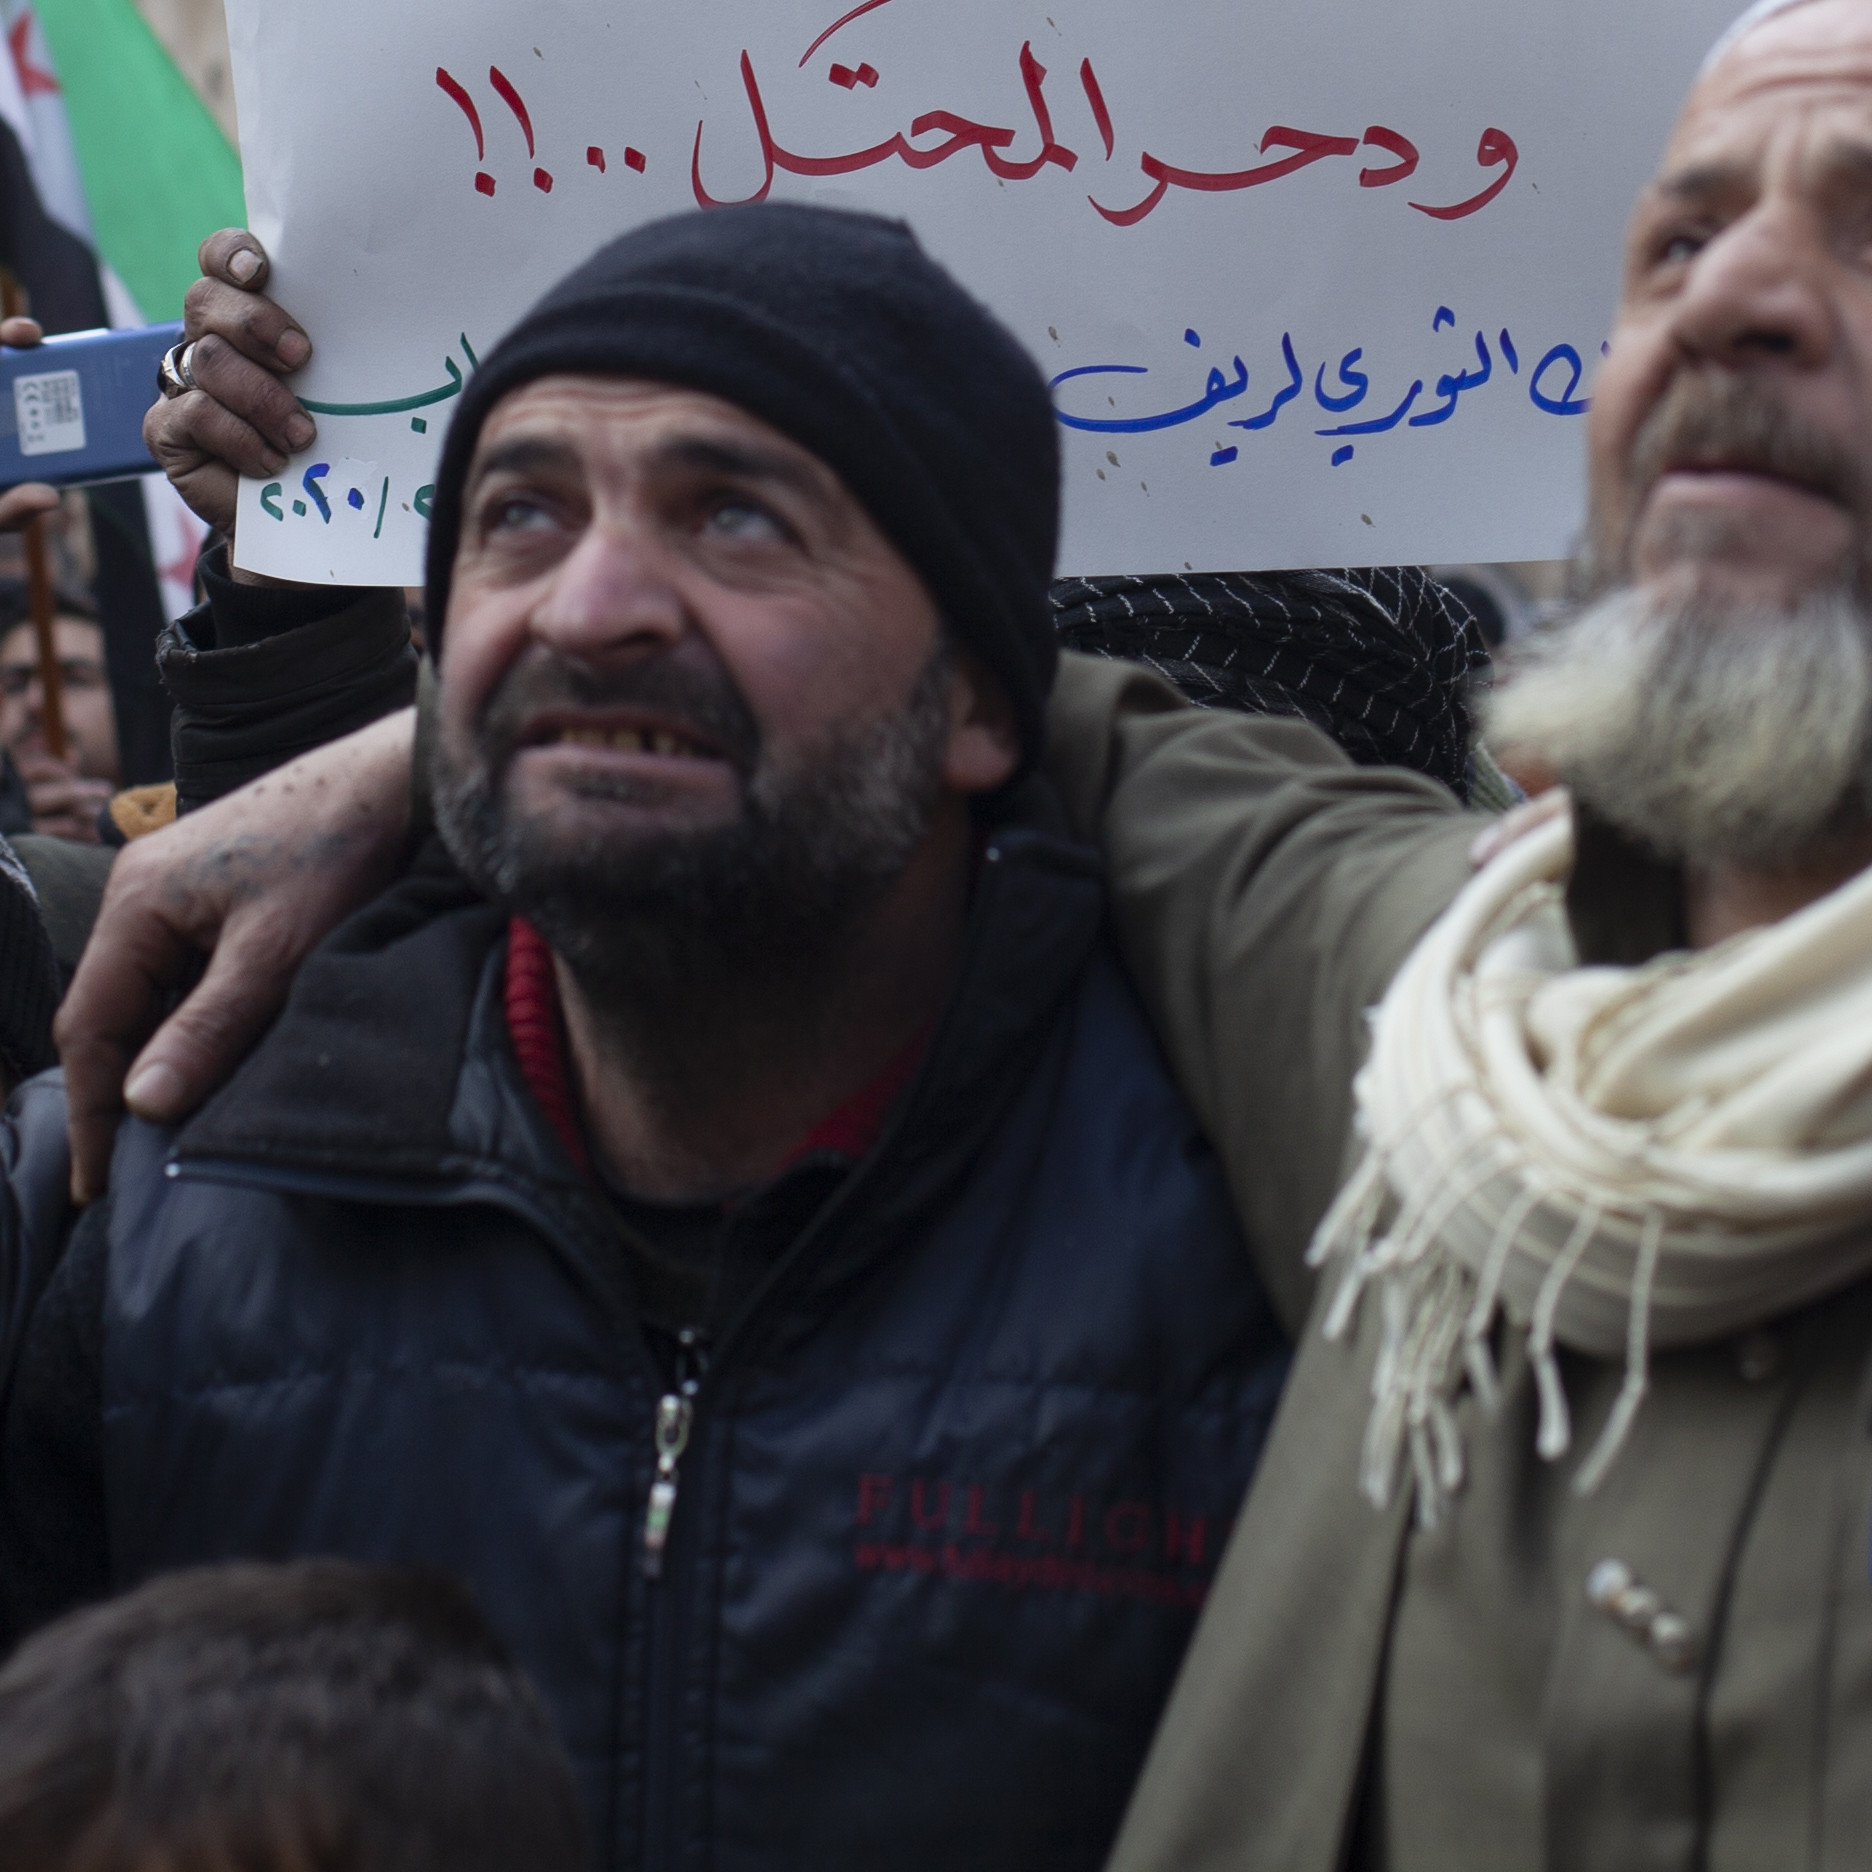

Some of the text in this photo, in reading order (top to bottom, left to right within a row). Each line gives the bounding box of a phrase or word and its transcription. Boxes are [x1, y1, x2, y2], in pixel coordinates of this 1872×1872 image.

[1088, 125, 1519, 227] ودحر
[1051, 328, 1305, 469] لريف
[1314, 305, 1520, 469] الثوري
[855, 1473, 1234, 1566] FULLIGH
